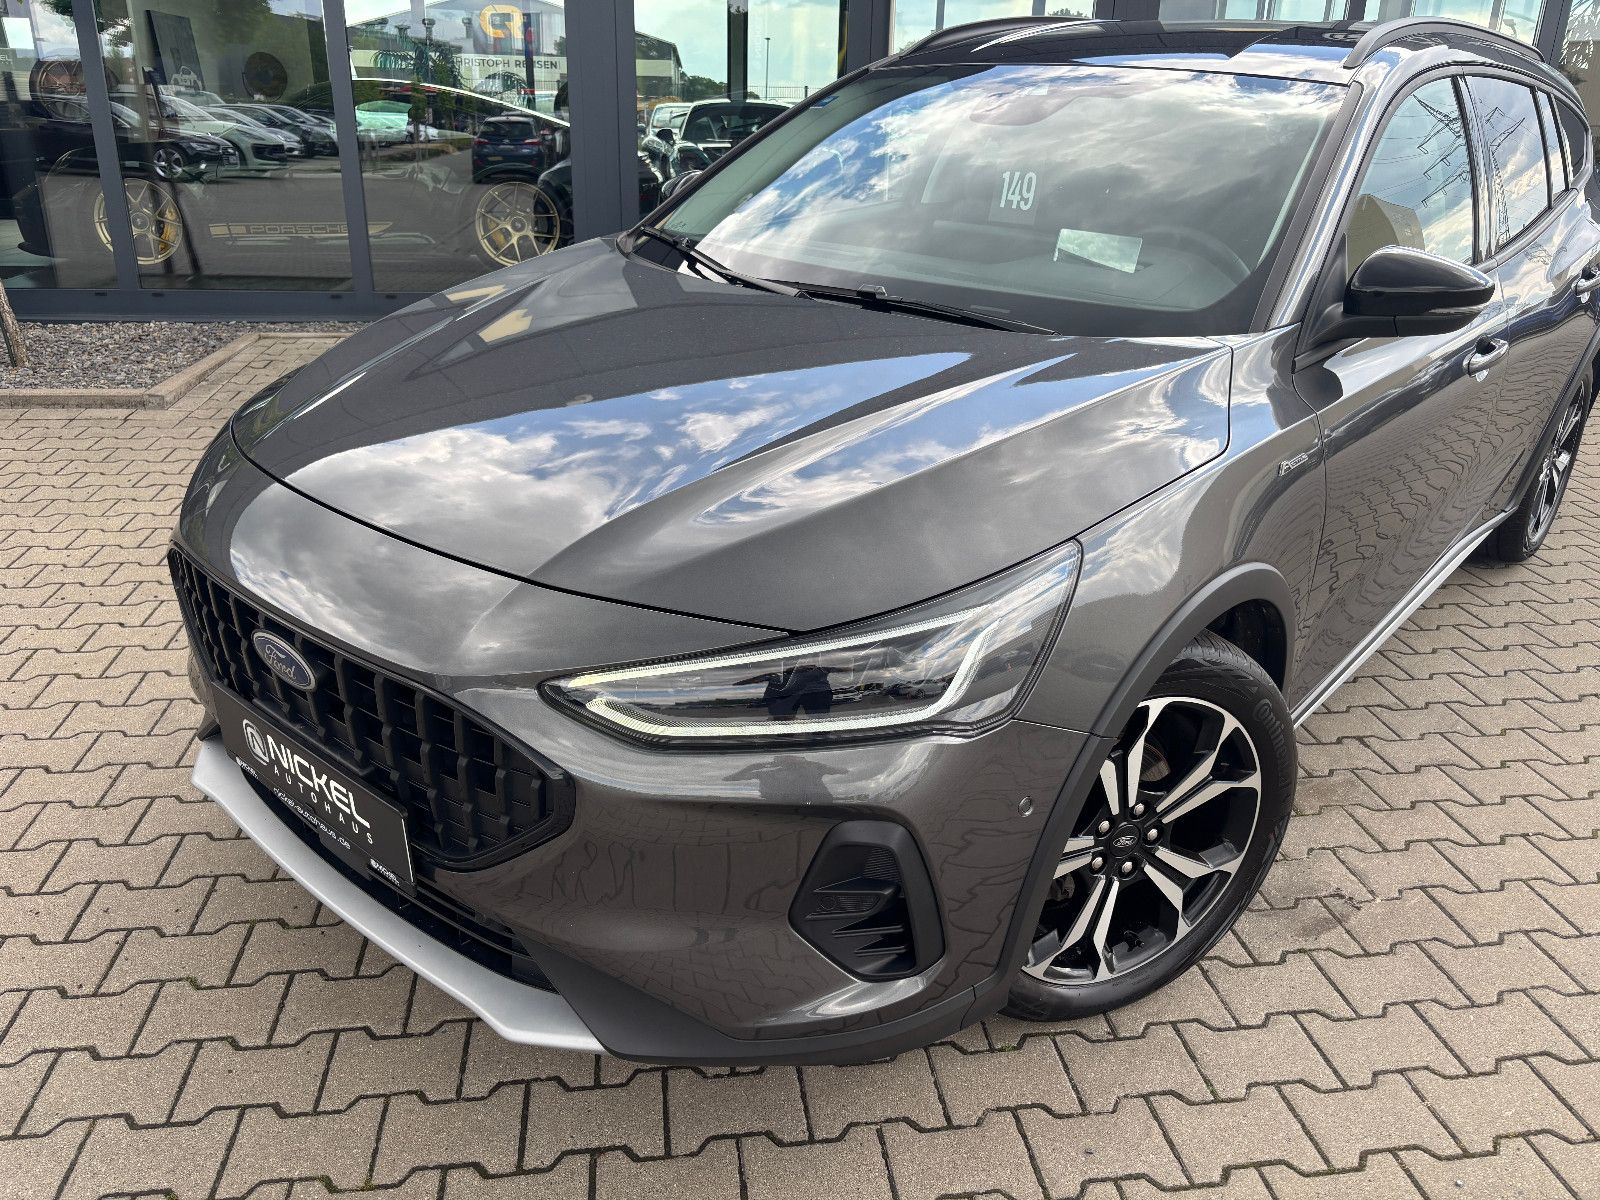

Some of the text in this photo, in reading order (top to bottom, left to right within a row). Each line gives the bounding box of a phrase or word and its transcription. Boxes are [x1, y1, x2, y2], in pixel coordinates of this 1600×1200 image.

[455, 56, 558, 70] HRISTOPH RESEN
[999, 171, 1037, 210] 149
[250, 224, 348, 234] PORSCHE
[264, 644, 298, 680] Ford
[266, 734, 371, 829] NICKEL
[273, 764, 374, 845] AUTOHAUS
